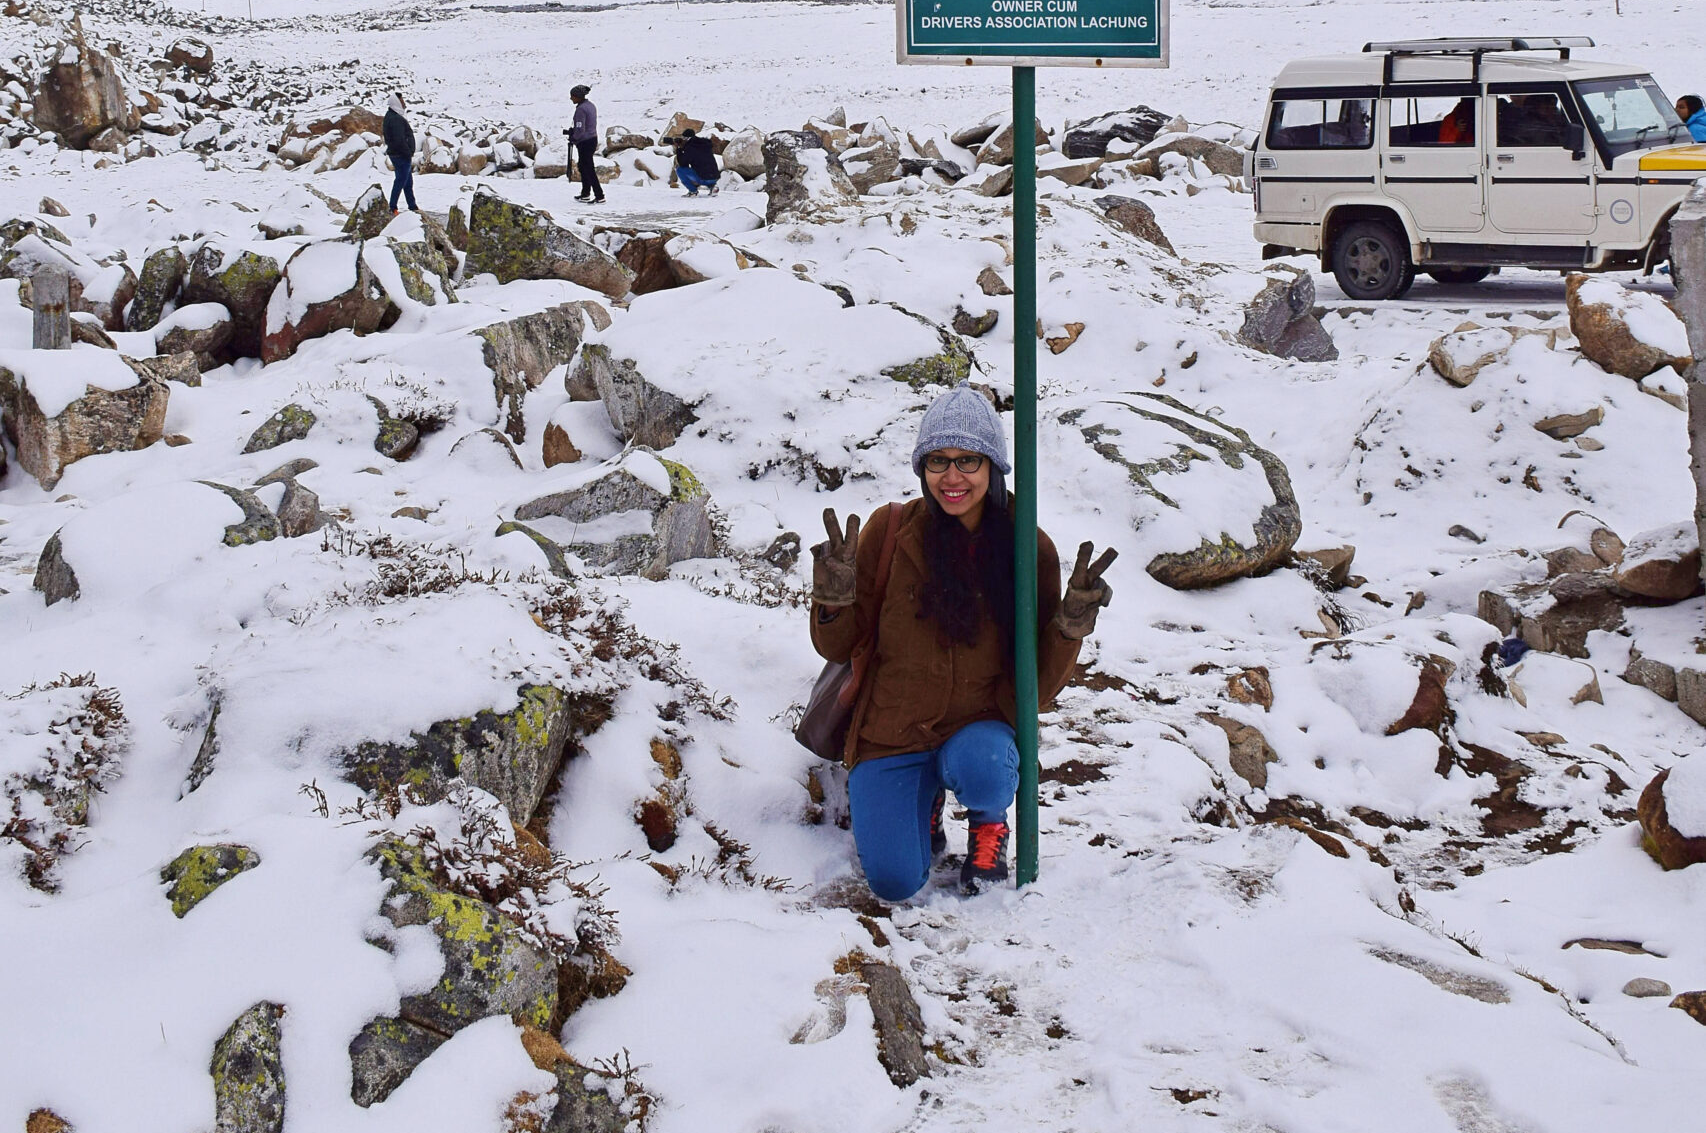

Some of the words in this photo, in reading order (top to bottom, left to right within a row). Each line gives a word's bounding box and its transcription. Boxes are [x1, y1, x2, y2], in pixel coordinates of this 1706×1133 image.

[991, 0, 1044, 13] OWNER
[1046, 0, 1078, 13] CUM
[921, 16, 982, 29] DRIVERS
[985, 16, 1077, 29] ASSOCIATION
[1080, 16, 1148, 29] LACHUNG
